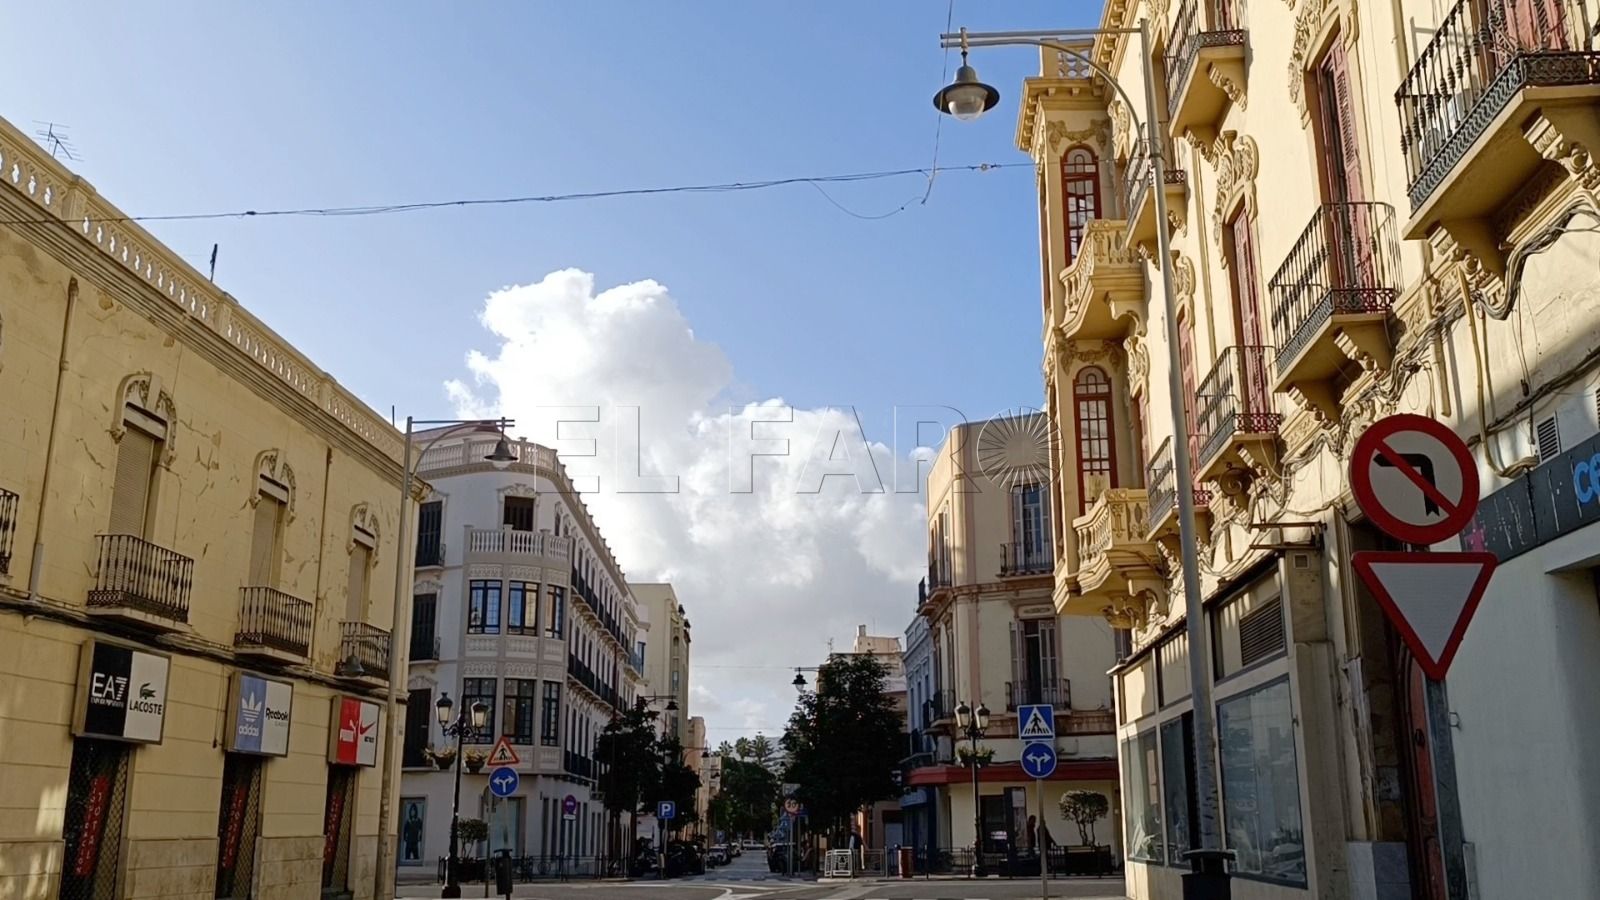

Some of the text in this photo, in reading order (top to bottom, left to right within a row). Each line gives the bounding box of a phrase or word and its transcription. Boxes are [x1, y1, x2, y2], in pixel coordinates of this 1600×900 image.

[92, 672, 128, 700] EA7
[129, 700, 163, 715] LACOSTE
[661, 803, 671, 816] P
